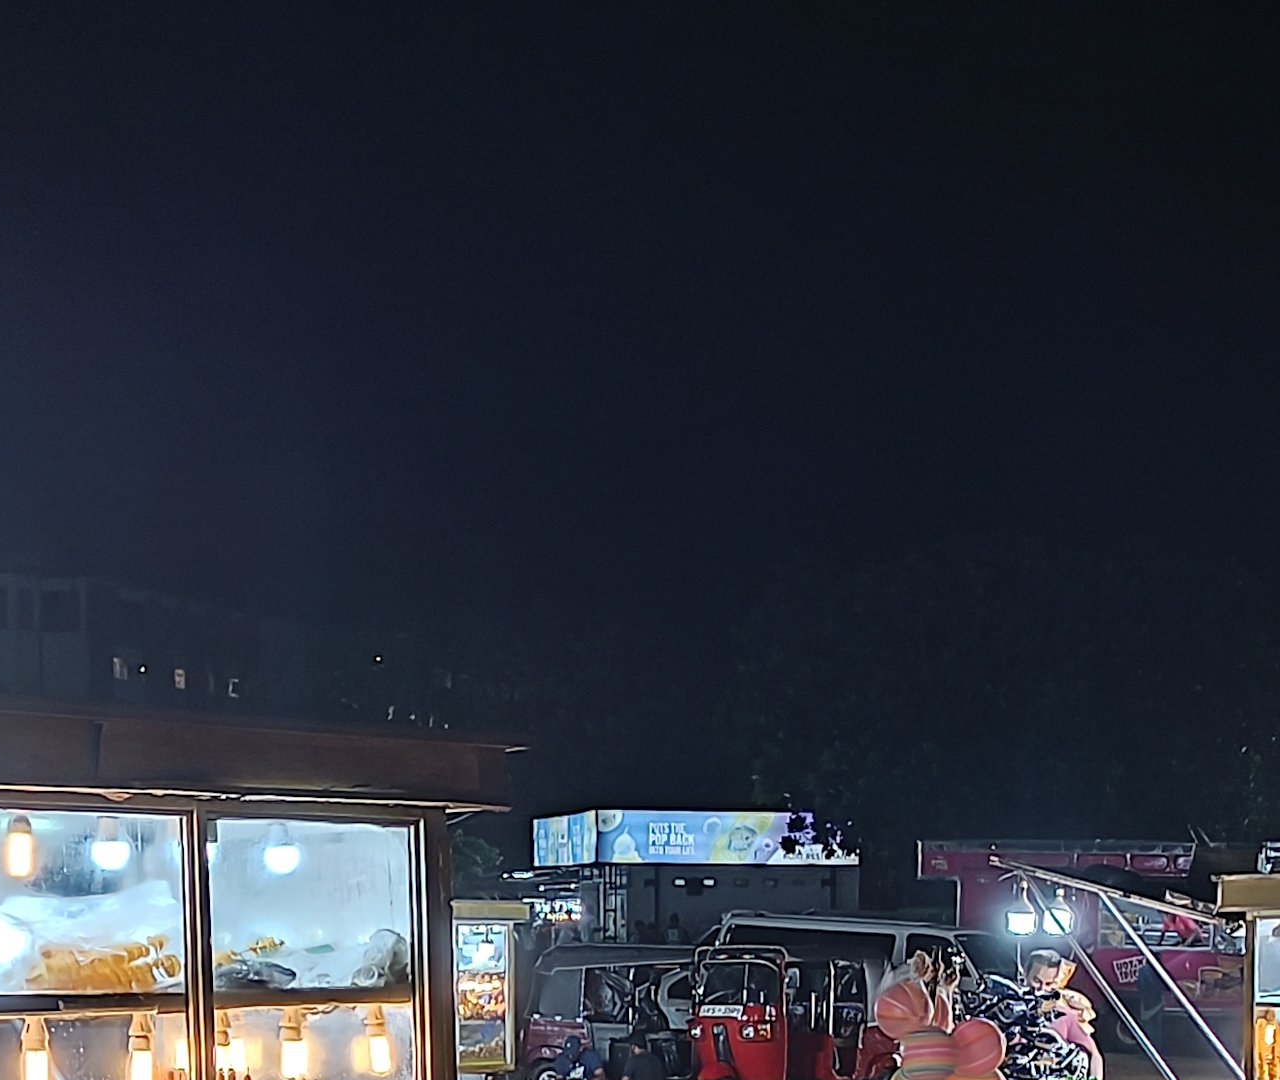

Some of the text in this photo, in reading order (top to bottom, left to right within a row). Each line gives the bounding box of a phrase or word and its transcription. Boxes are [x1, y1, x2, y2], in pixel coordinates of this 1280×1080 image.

[649, 823, 670, 834] PUTS
[649, 834, 695, 846] POP BACK
